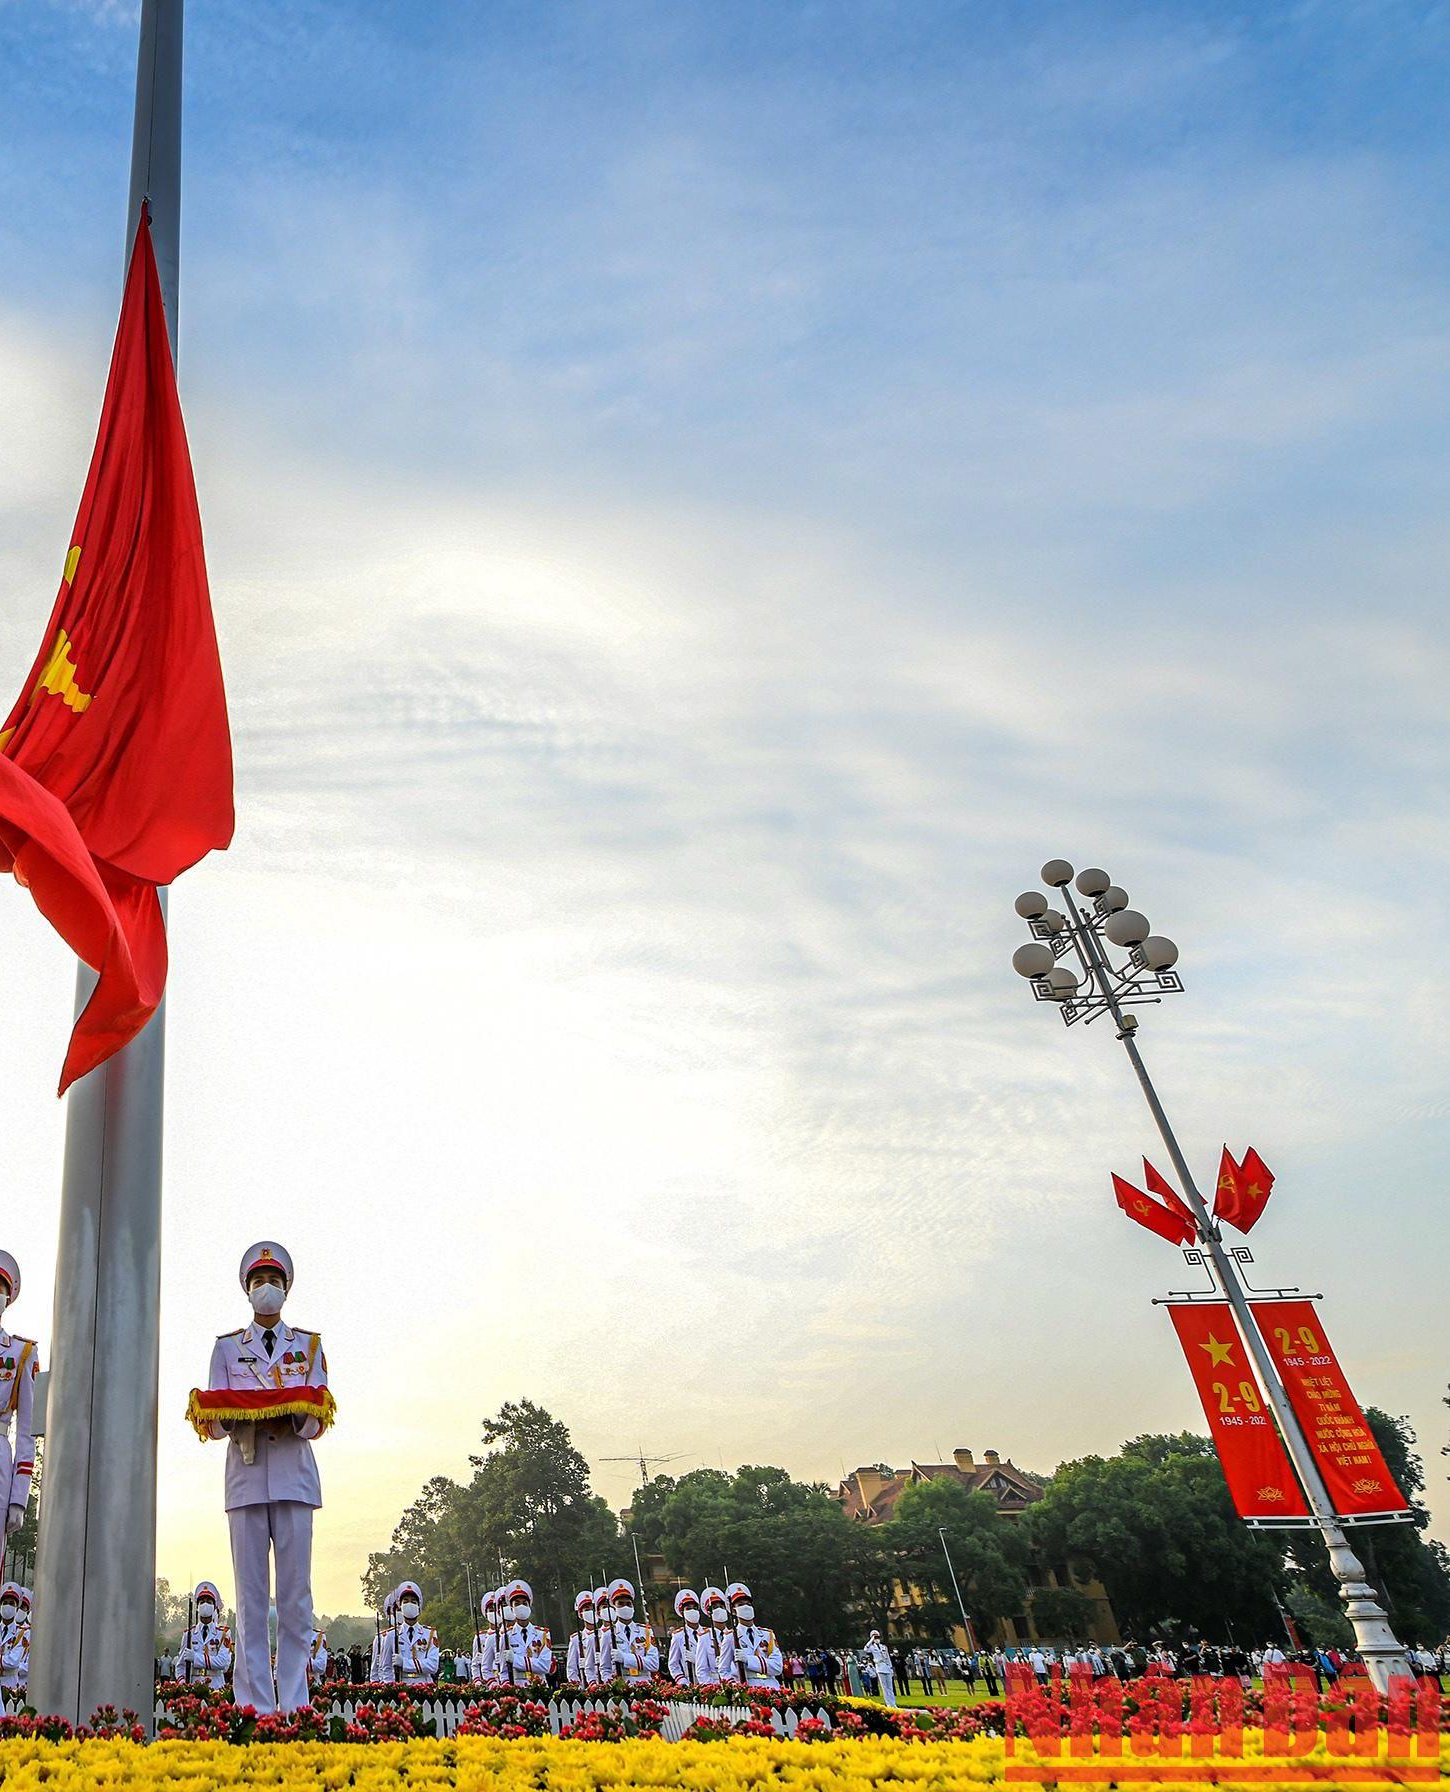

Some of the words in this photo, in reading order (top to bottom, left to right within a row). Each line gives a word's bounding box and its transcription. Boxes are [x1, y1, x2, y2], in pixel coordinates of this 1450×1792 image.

[1274, 1326, 1319, 1355] 2-9
[1283, 1357, 1305, 1366] 1945
[1310, 1355, 1332, 1366] 2022
[1212, 1381, 1260, 1413] 2-9
[1219, 1416, 1244, 1425] 1945
